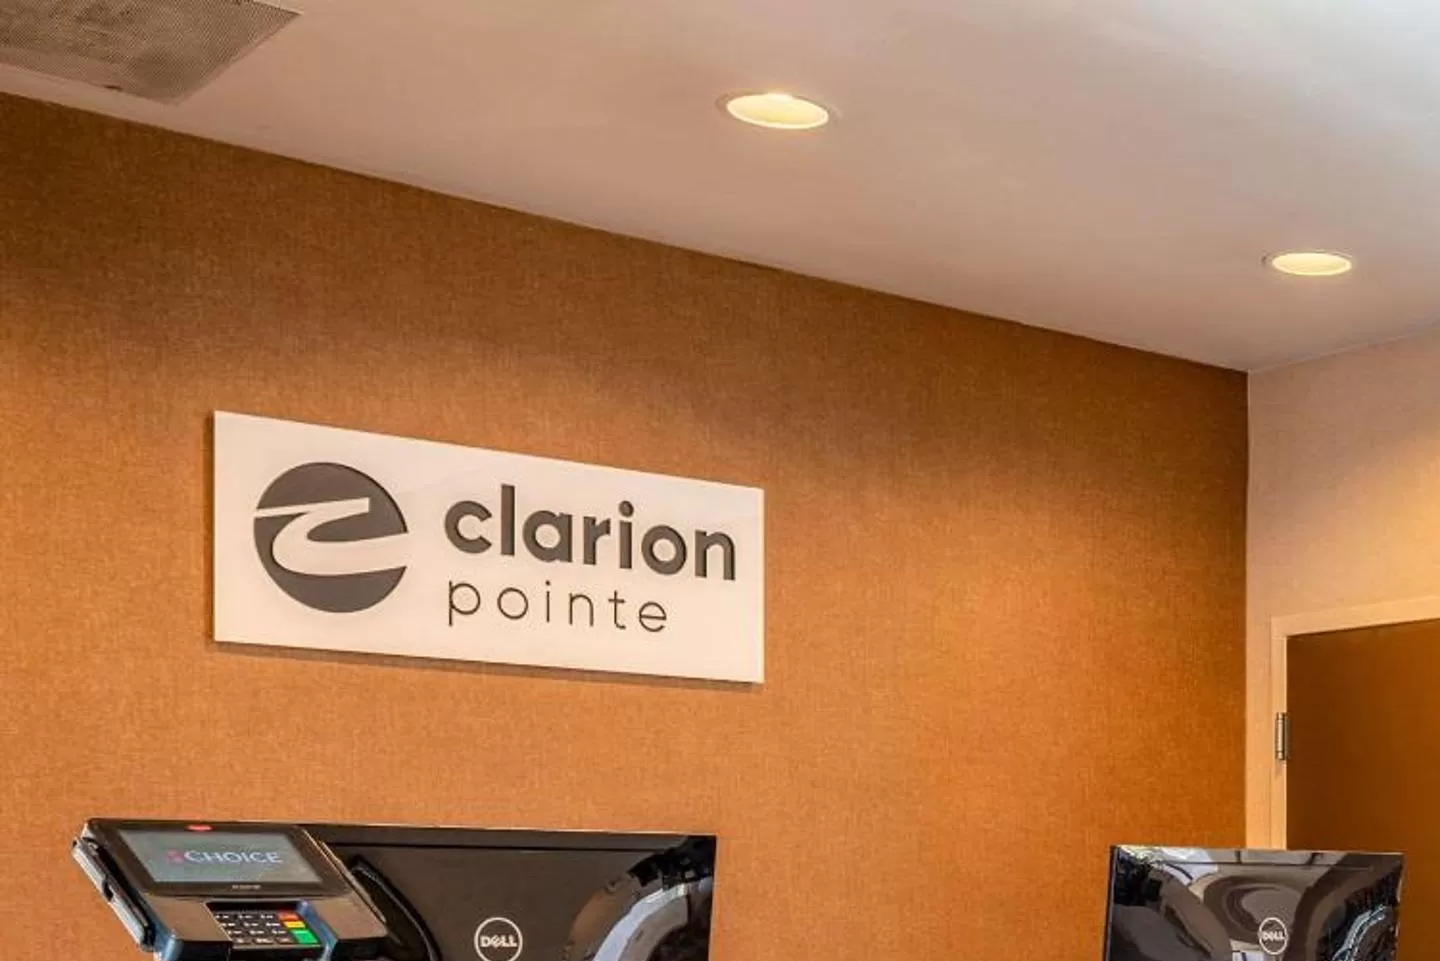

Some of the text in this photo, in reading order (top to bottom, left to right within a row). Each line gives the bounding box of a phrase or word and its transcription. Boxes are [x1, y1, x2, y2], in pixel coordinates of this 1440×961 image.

[444, 484, 736, 581] clarion
[448, 580, 667, 633] pointe
[184, 850, 284, 865] CHOICE
[480, 935, 518, 949] DELL
